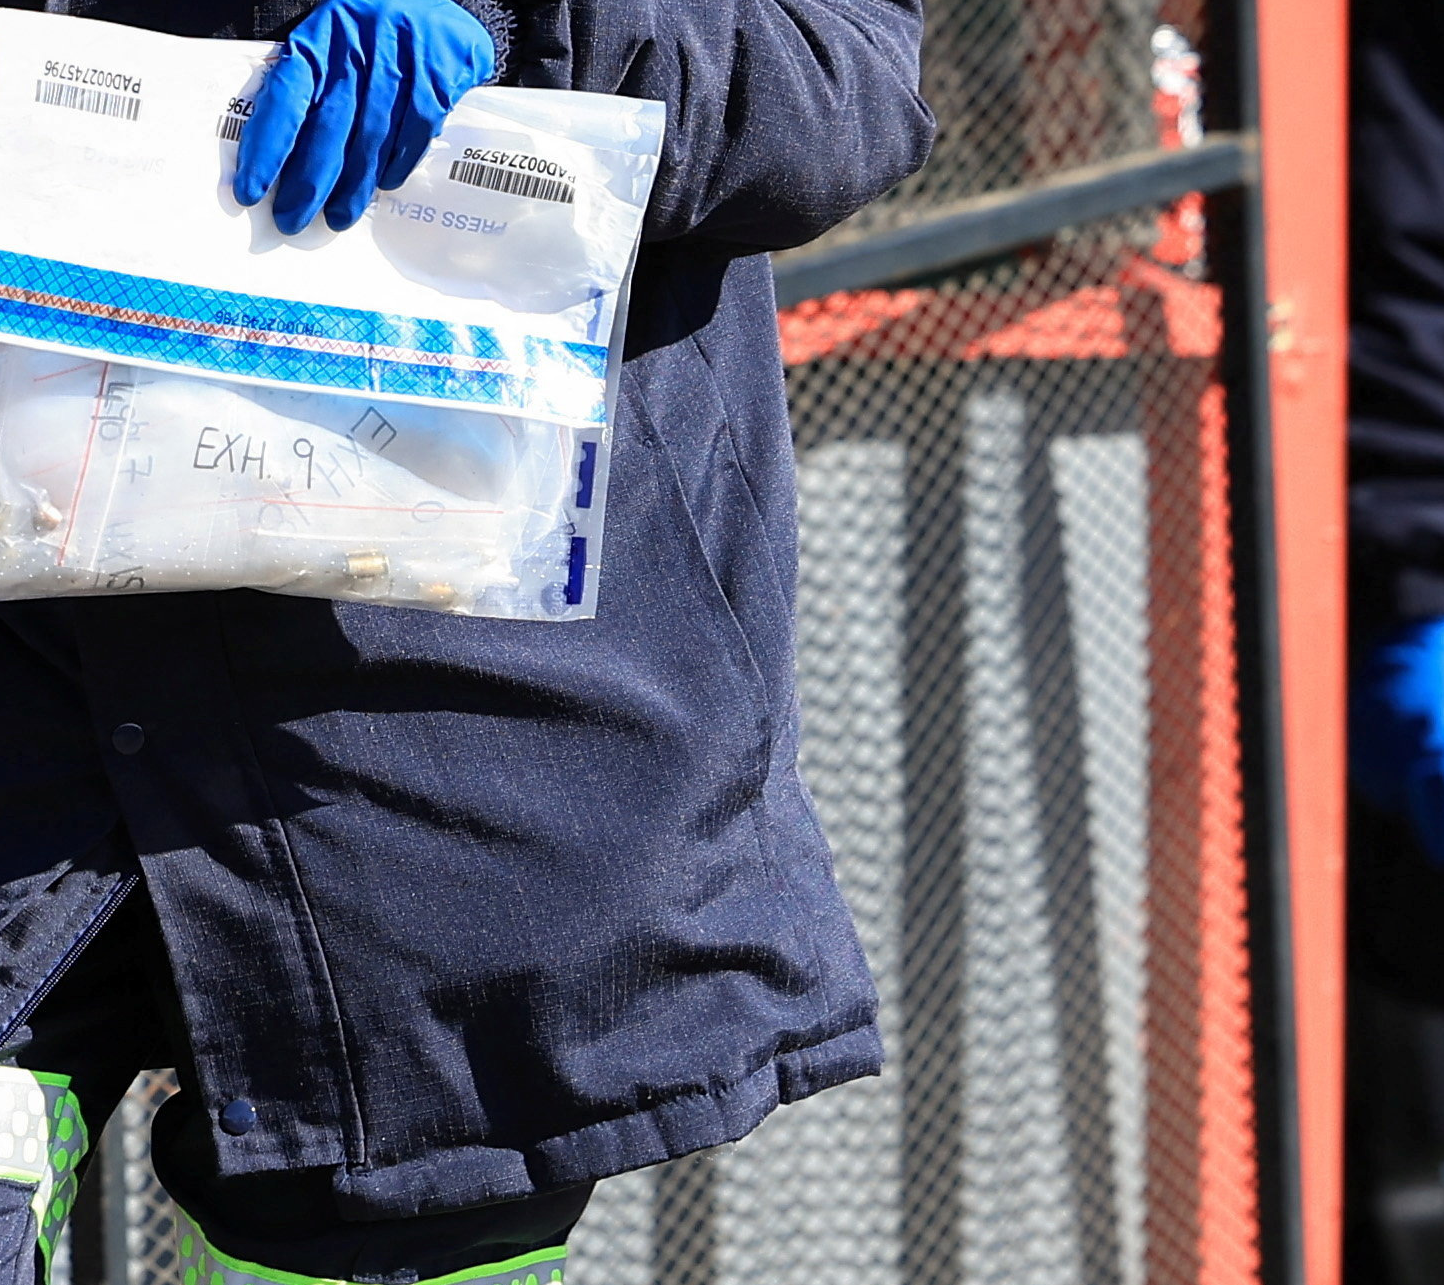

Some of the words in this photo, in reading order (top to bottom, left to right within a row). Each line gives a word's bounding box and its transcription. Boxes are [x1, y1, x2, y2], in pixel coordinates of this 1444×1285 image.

[43, 59, 142, 95] PAD002745796
[462, 147, 577, 184] PAD002745796
[386, 196, 437, 223] SEAL
[441, 210, 508, 236] PRESS
[292, 437, 315, 490] 9
